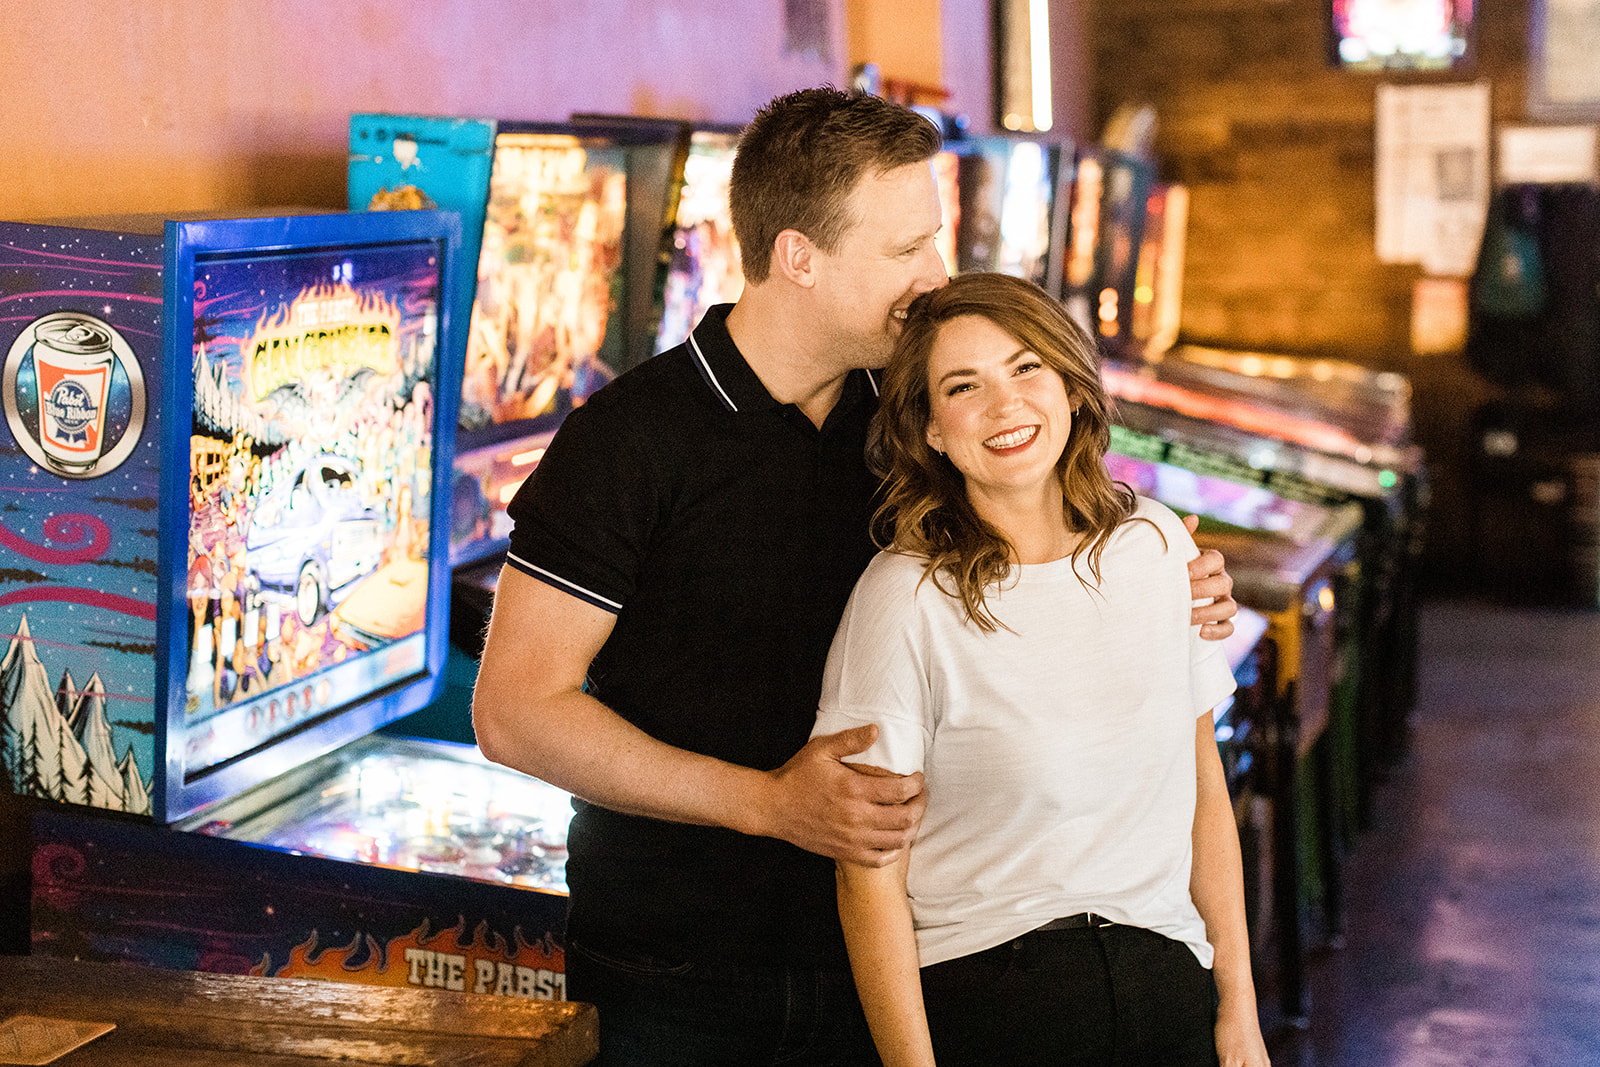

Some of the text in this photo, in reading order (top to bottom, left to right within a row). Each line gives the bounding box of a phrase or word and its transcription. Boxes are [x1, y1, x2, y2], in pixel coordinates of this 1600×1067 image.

[56, 387, 85, 406] Pabst
[67, 407, 96, 420] Ribbon
[405, 948, 567, 1002] THE PABST
